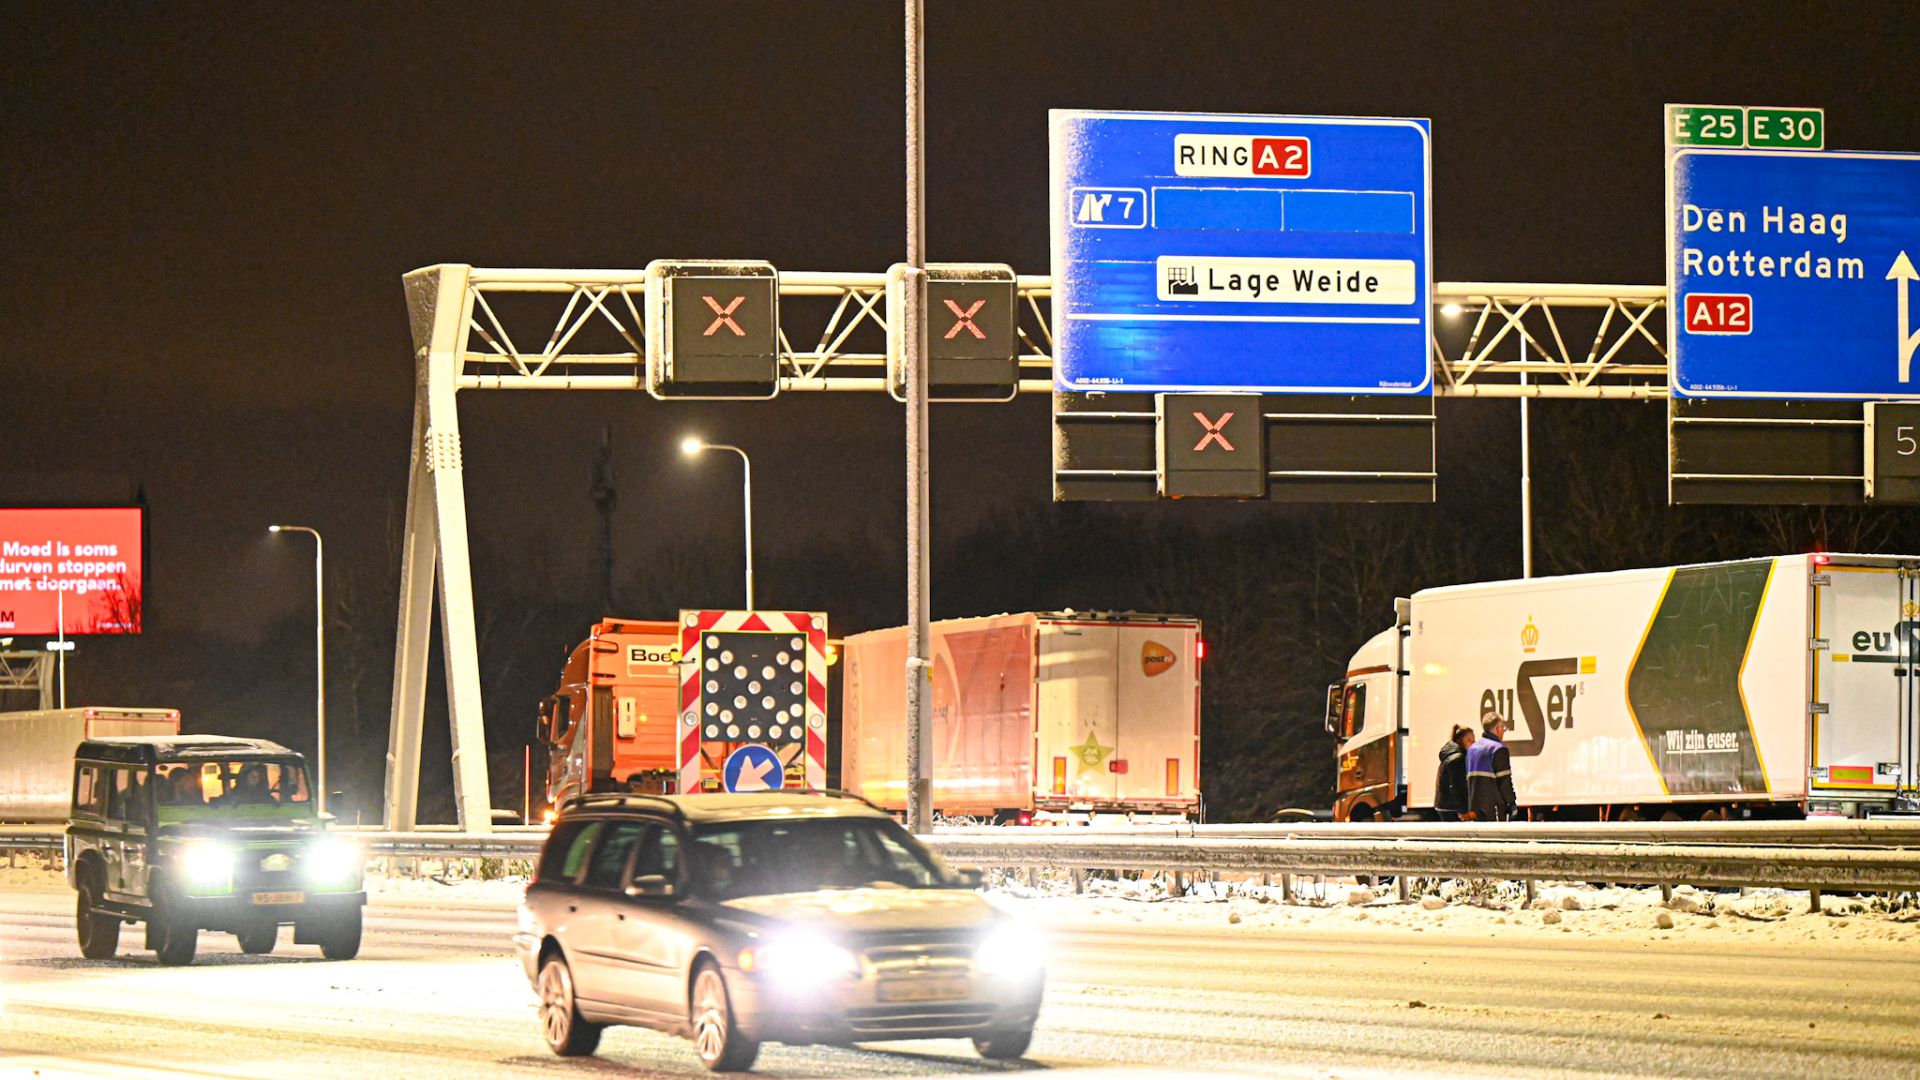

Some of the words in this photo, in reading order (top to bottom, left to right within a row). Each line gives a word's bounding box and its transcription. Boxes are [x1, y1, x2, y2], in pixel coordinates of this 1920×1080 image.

[1675, 114, 1691, 137] E
[1700, 115, 1736, 139] 25
[1754, 116, 1769, 140] E
[1778, 117, 1815, 141] 30
[1180, 145, 1248, 166] RING
[1257, 145, 1303, 169] A2
[1118, 197, 1134, 219] 7
[1683, 204, 1746, 232] Den
[1762, 206, 1847, 243] Haag
[1683, 248, 1865, 279] Rotterdam
[1209, 268, 1280, 298] Lage
[1292, 269, 1379, 292] Weide
[1692, 302, 1746, 326] A12
[1897, 426, 1917, 456] 5
[3, 540, 52, 557] Moed
[56, 540, 70, 557] is
[74, 544, 118, 557] soms
[57, 559, 127, 578] stoppen
[0, 577, 32, 591] met
[36, 575, 121, 595] doorgaan.
[1666, 729, 1684, 755] Wij
[1685, 729, 1705, 755] zijn
[1706, 732, 1739, 750] euser.
